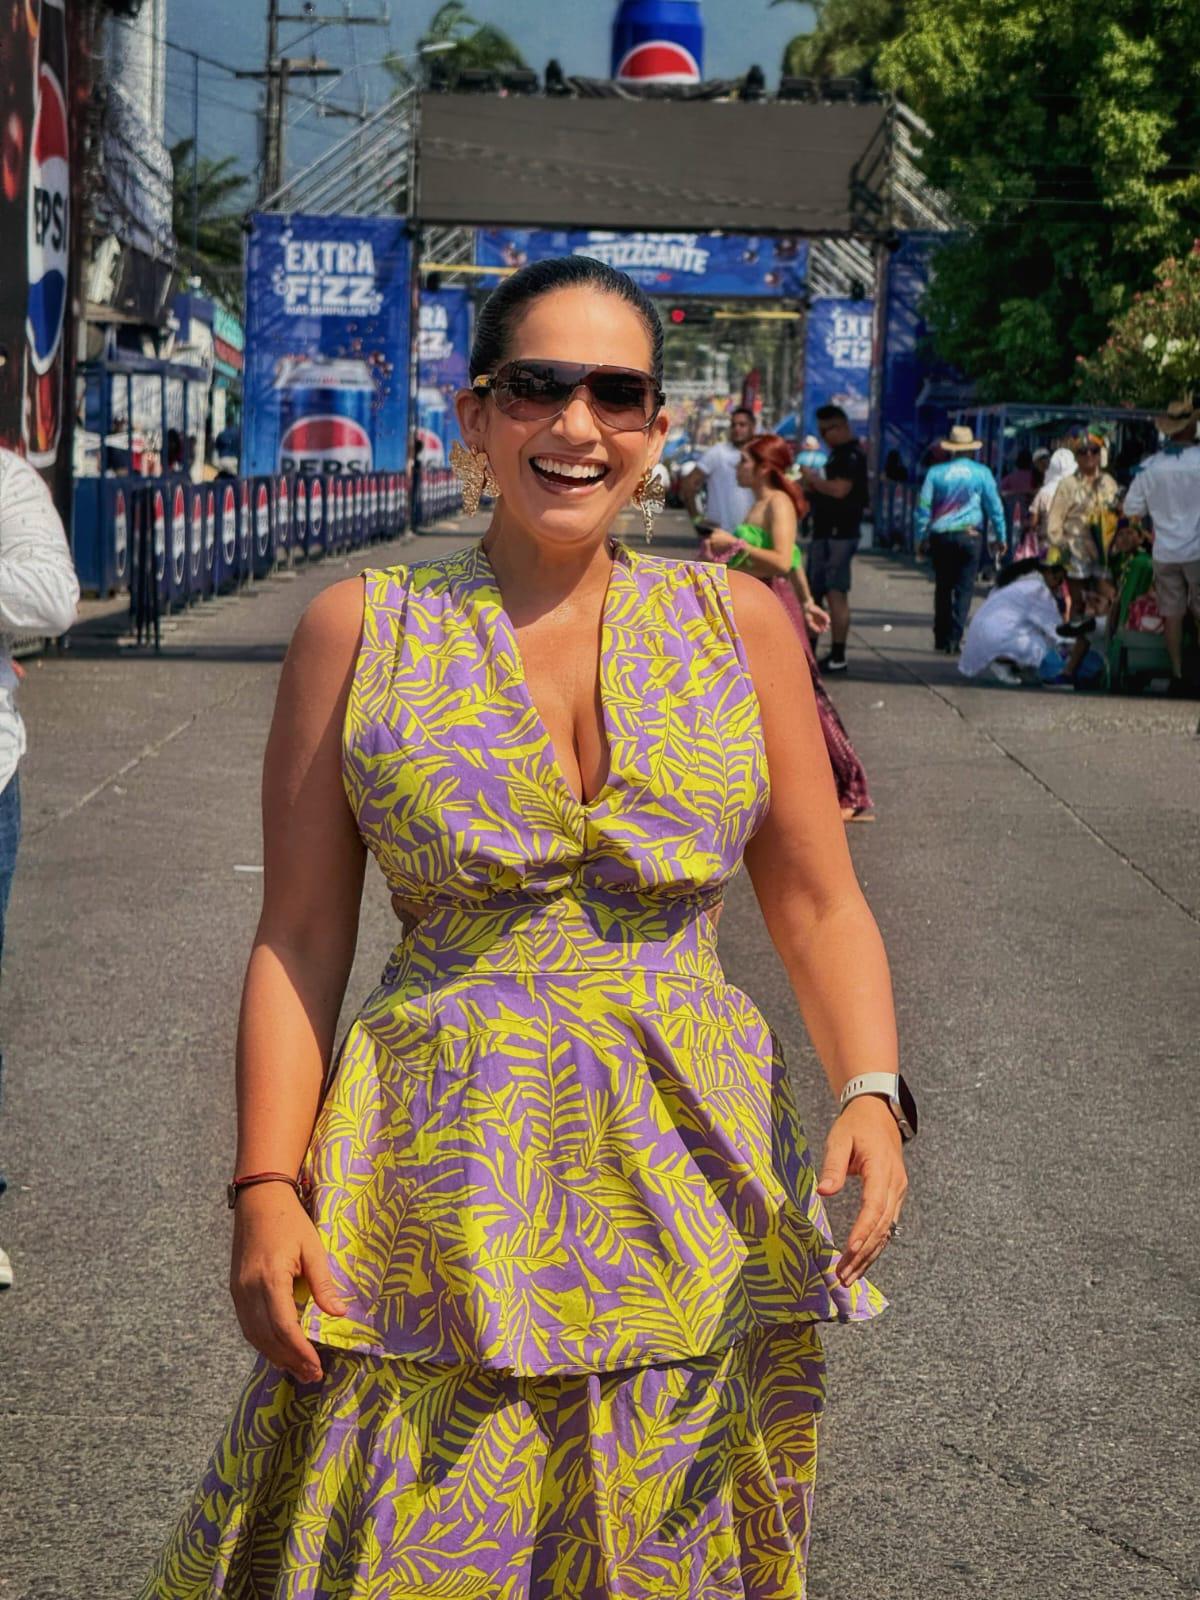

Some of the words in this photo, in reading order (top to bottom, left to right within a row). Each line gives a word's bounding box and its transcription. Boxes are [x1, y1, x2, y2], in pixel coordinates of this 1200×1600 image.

[285, 240, 375, 273] EXTRA
[834, 315, 873, 337] EXT
[281, 458, 369, 475] PEPSI
